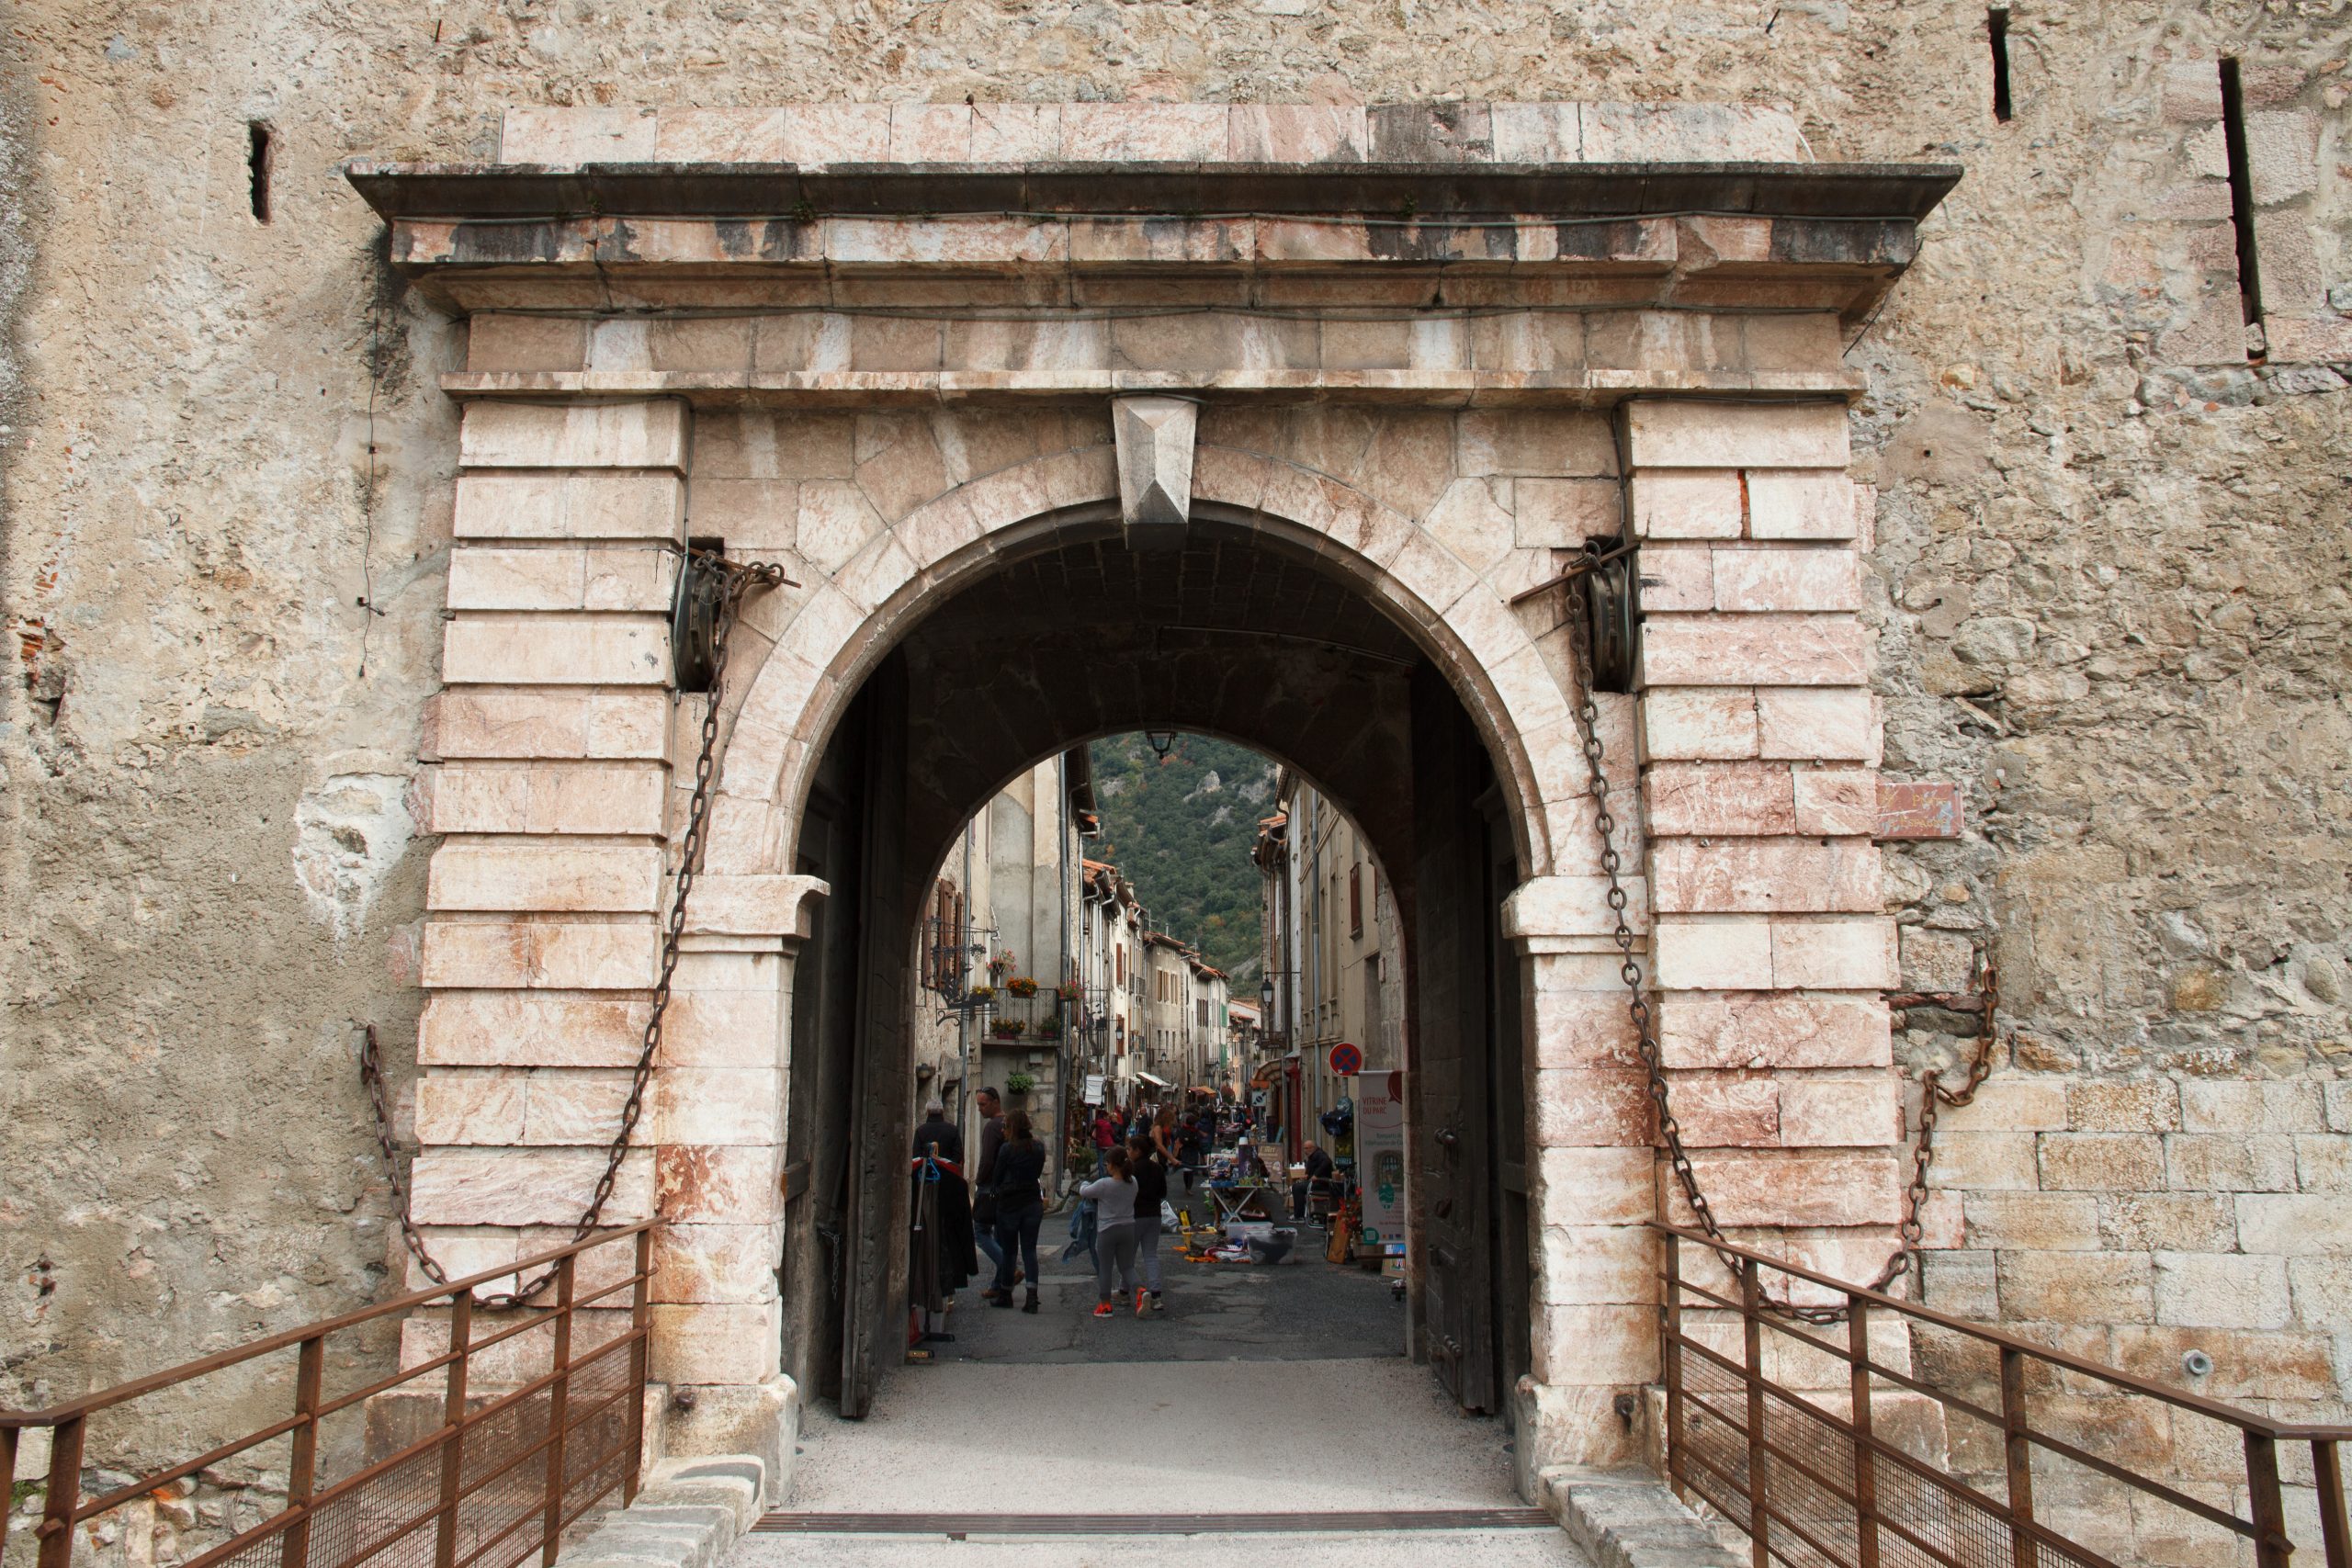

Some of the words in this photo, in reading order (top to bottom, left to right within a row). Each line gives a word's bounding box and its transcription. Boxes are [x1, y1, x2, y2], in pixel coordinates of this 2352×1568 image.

[1363, 1097, 1386, 1105] VITRINE
[1363, 1106, 1372, 1114] DU
[1373, 1106, 1387, 1114] PARC
